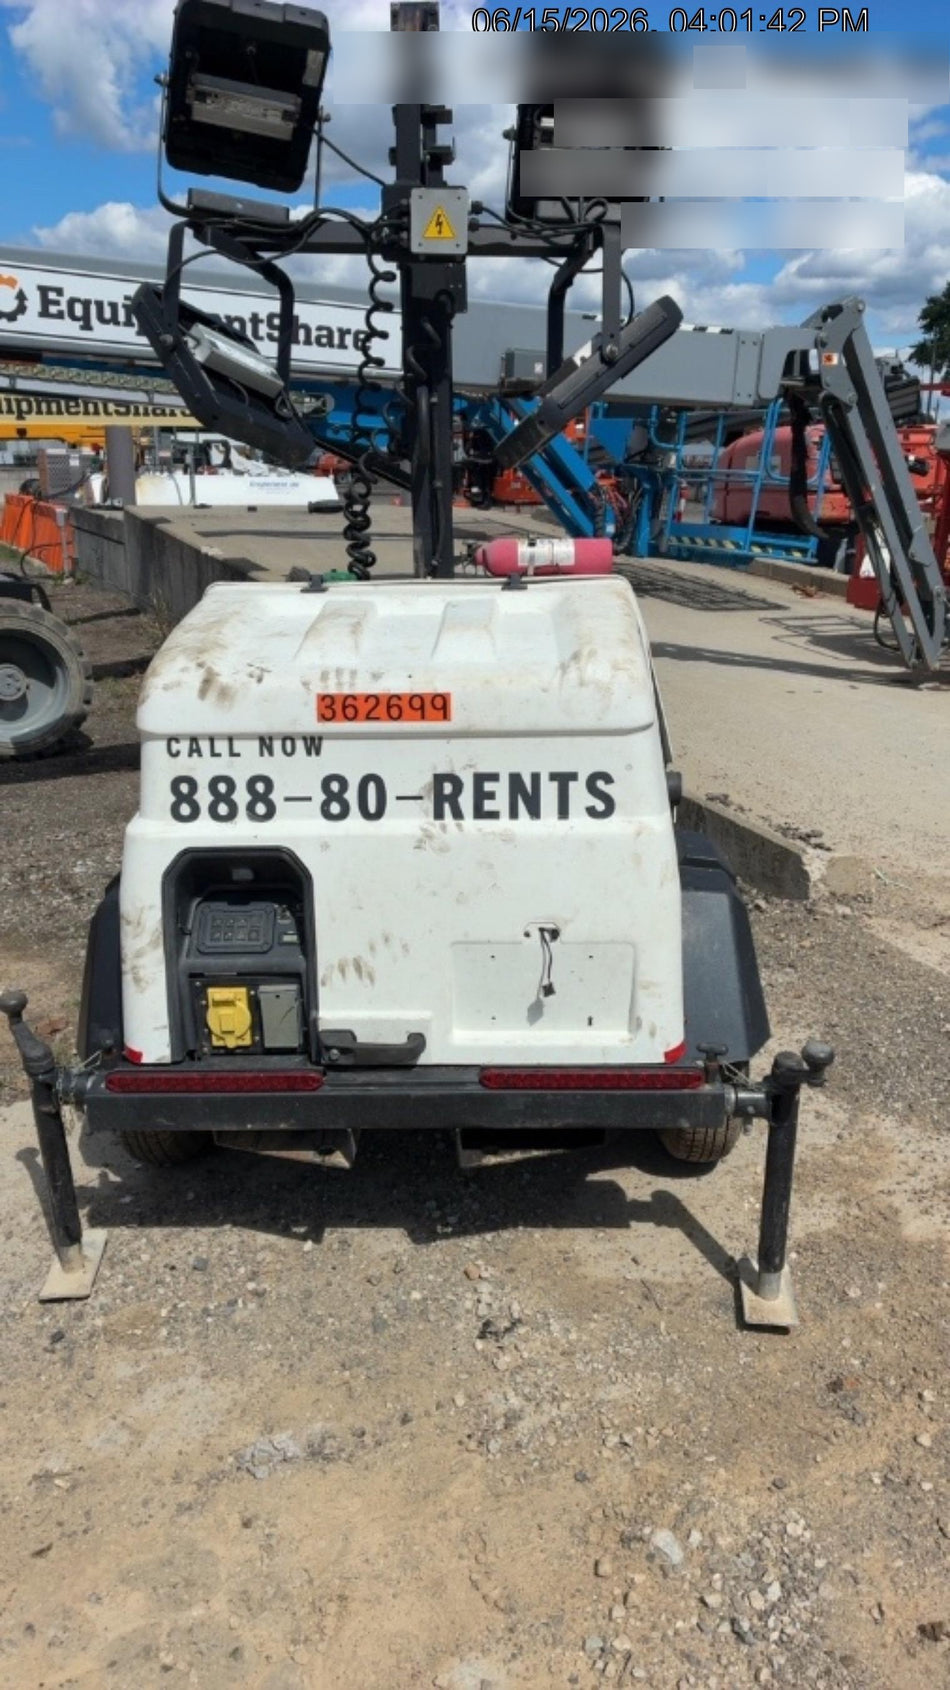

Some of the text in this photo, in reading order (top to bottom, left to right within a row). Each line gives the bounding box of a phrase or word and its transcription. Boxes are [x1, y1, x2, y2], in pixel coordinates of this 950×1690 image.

[320, 694, 448, 721] 362699
[166, 736, 324, 758] CALL NOW
